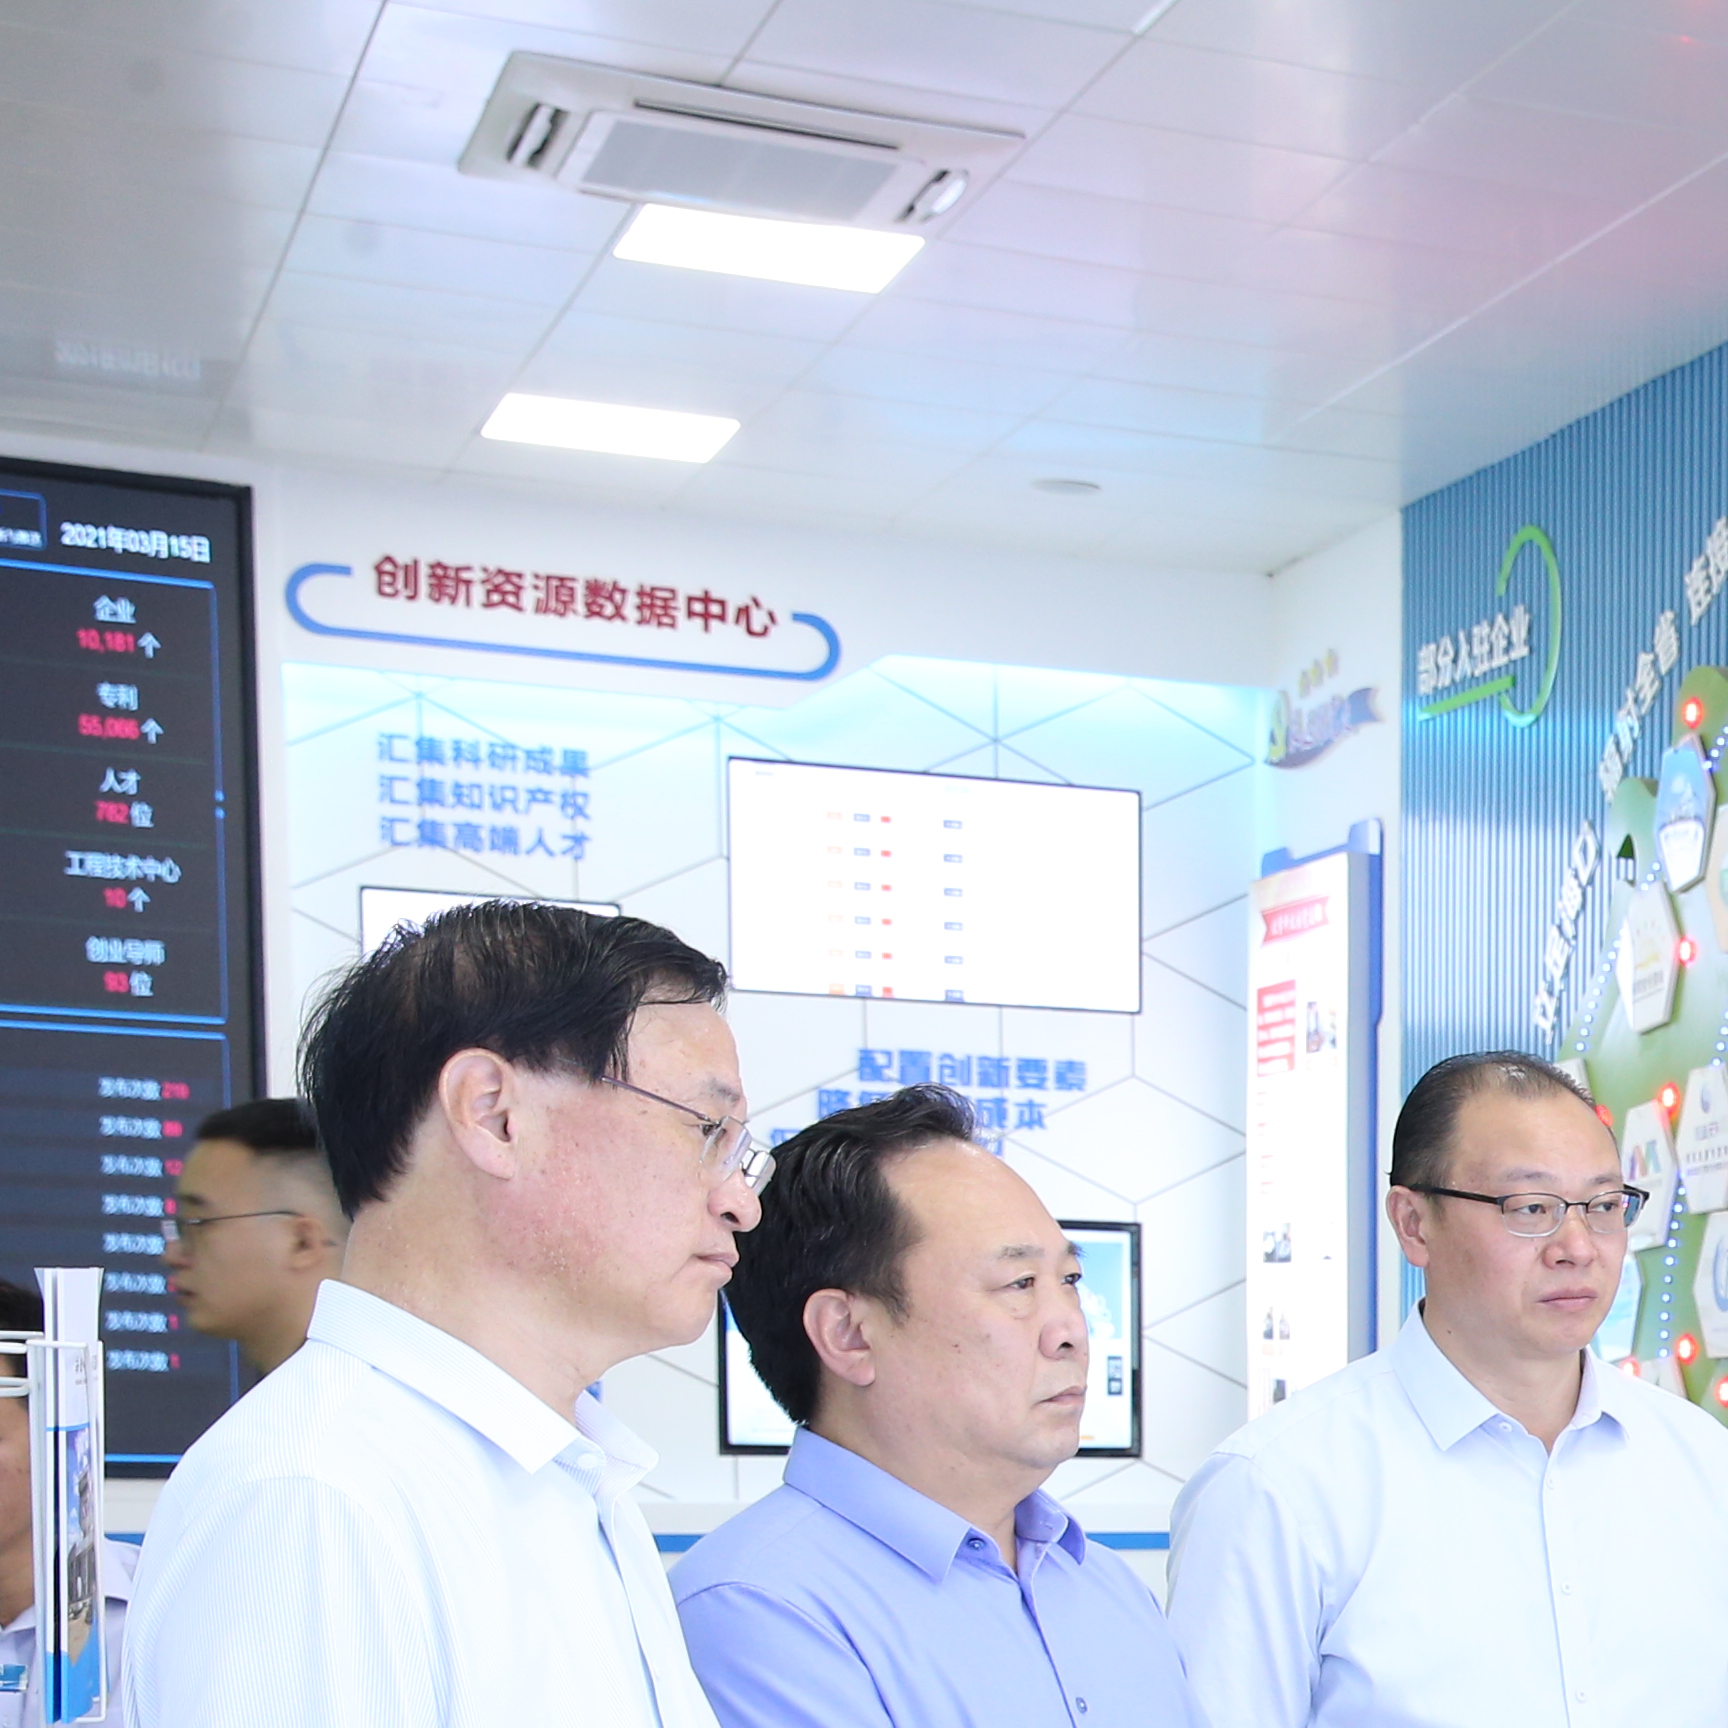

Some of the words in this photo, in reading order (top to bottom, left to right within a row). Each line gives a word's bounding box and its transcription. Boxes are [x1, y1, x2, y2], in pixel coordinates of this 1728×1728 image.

[60, 521, 212, 564] 2021年03月15日
[93, 594, 137, 624] 企业
[373, 553, 778, 638] 创新资源数据中心
[377, 732, 591, 778] 汇集科研成果
[99, 766, 142, 795] 人才
[379, 775, 592, 820] 汇集知识产权
[380, 815, 592, 861] 汇集高端人才
[64, 849, 182, 884] 工程技术中心
[858, 1048, 1088, 1093] 配置创新要素
